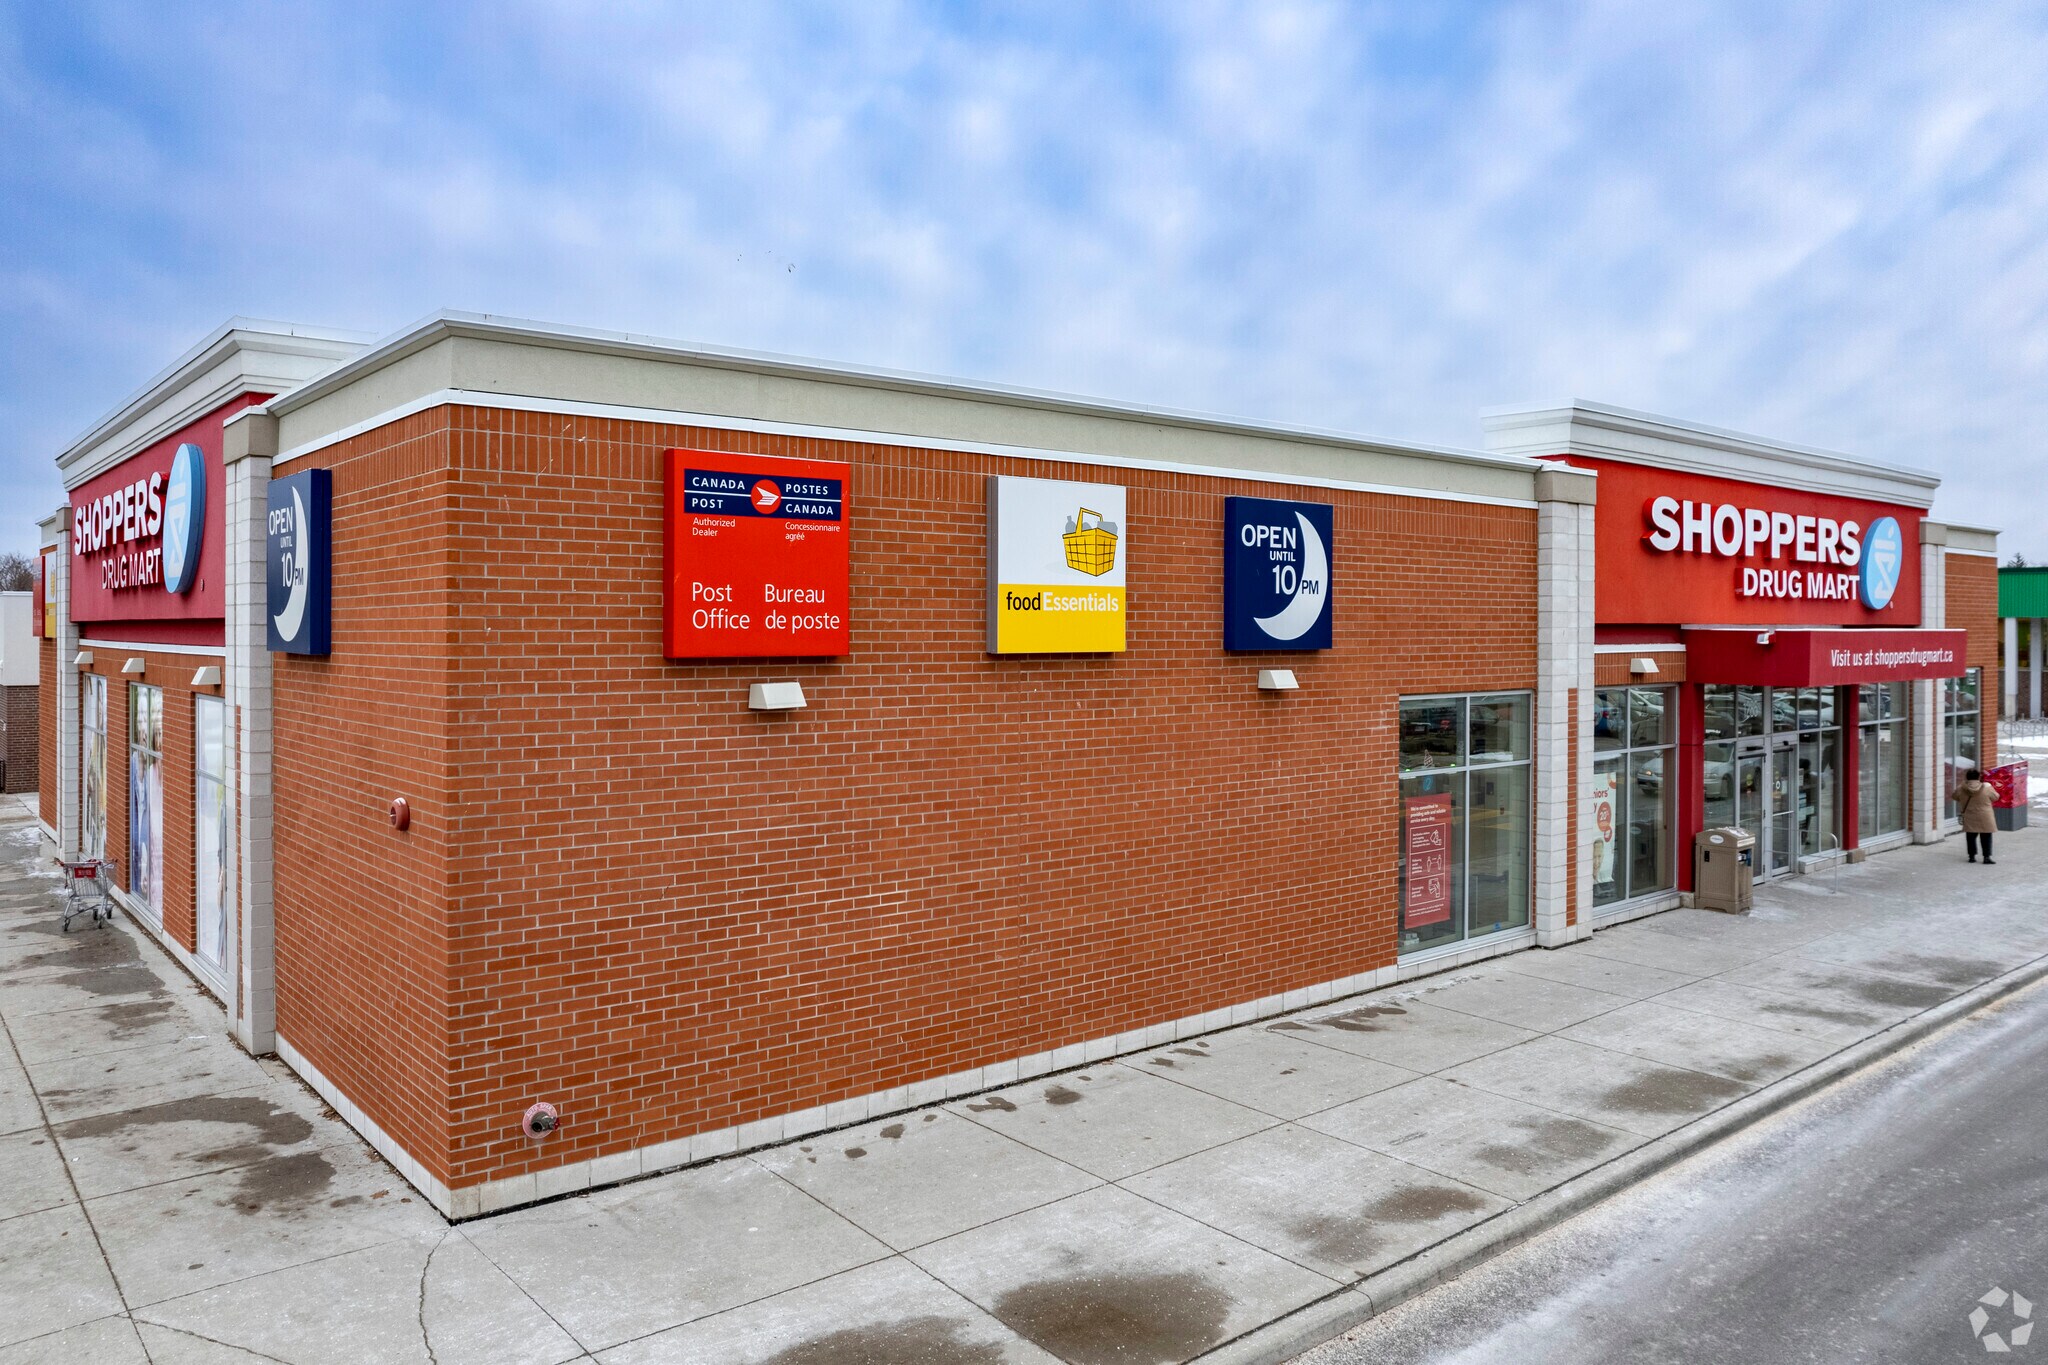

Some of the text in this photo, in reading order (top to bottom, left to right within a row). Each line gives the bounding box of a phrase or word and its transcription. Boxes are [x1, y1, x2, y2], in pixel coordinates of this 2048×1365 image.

[692, 476, 745, 490] CANADA
[785, 483, 829, 495] POSTES
[74, 471, 162, 556] SHOPPERS
[692, 498, 724, 509] POST
[785, 504, 834, 515] CANADA
[268, 506, 293, 536] OPEN
[692, 517, 736, 528] Authorized
[785, 521, 841, 533] Concessionnaire
[1649, 495, 1861, 567] SHOPPERS
[280, 535, 293, 548] UNTIL
[692, 528, 718, 537] Dealer
[785, 532, 805, 541] agréé
[1241, 523, 1297, 549] OPEN
[1269, 550, 1296, 562] UNTIL
[102, 547, 161, 590] DRUG MART
[281, 552, 304, 588] 10 PM
[1272, 564, 1319, 596] 10 PM
[1743, 567, 1860, 601] DRUG MART
[692, 582, 733, 602] Post
[764, 583, 825, 603] Bureau
[692, 608, 750, 629] Office
[765, 609, 840, 634] de poste
[1831, 647, 1953, 668] Visit us at shoppersdrugmart.ca
